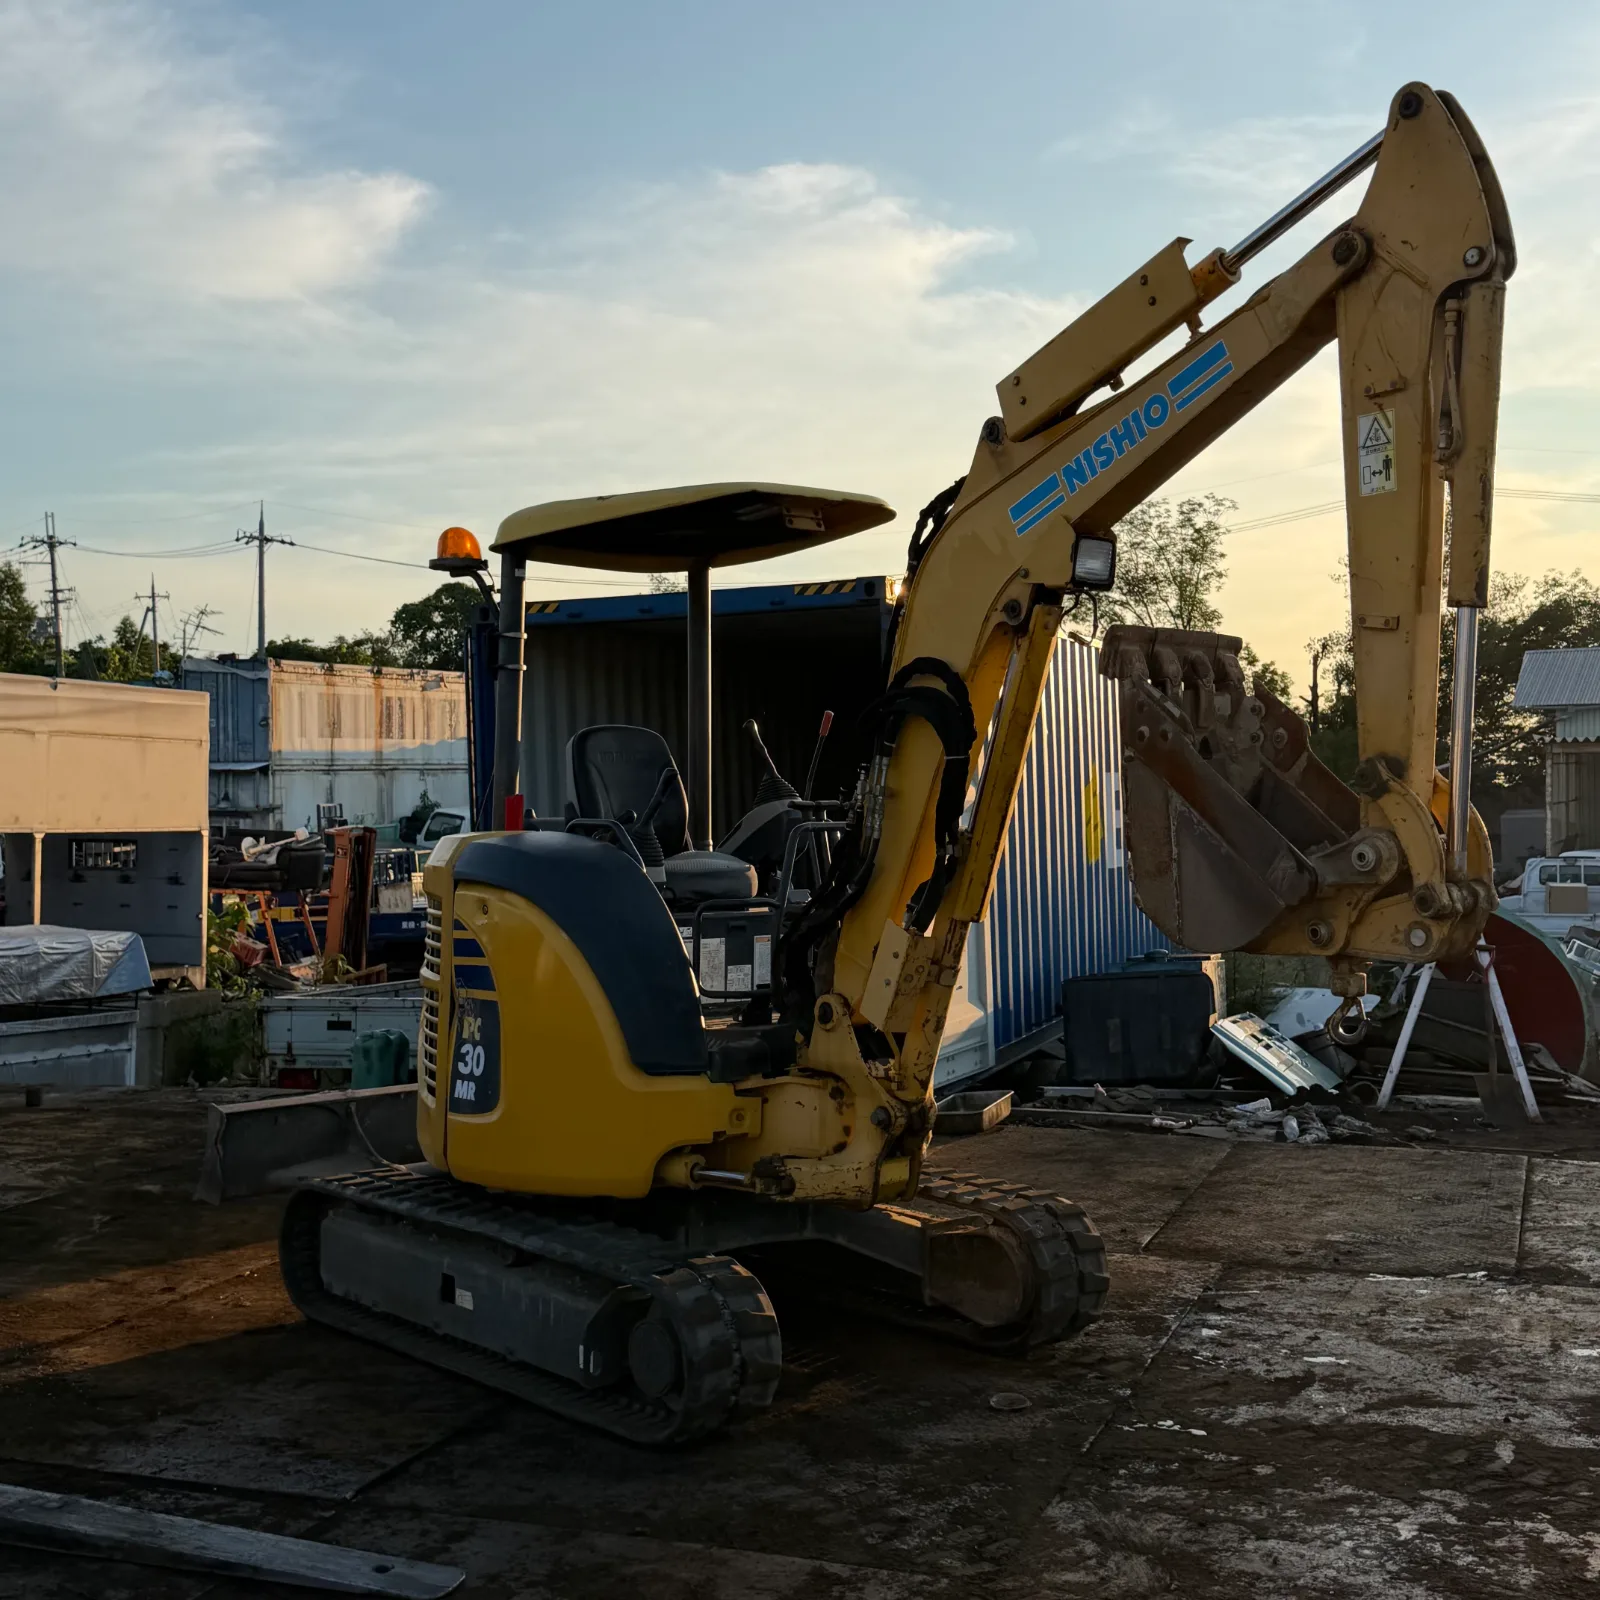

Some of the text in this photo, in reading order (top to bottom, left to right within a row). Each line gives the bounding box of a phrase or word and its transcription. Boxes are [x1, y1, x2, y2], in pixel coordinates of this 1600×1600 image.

[1061, 393, 1170, 496] NISHIO
[462, 1017, 482, 1040] PC
[457, 1043, 486, 1077] 30
[454, 1079, 476, 1101] MR
